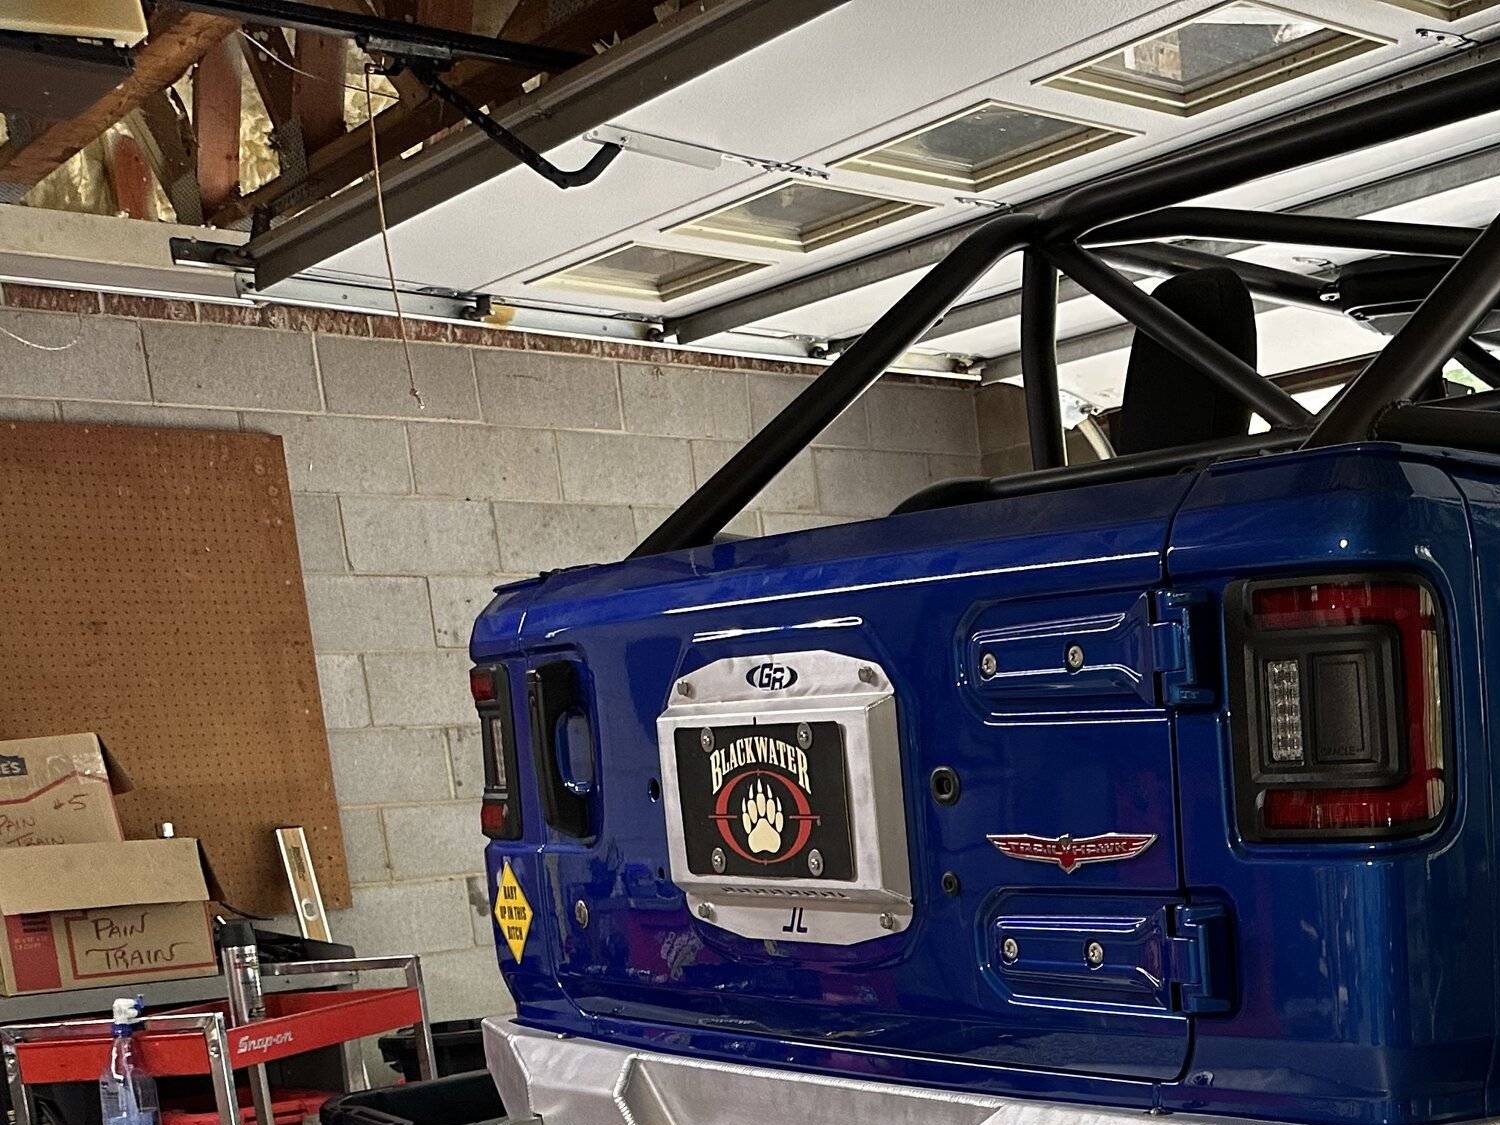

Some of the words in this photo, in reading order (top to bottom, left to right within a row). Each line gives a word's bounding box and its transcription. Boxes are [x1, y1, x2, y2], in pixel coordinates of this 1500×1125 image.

[709, 735, 812, 796] BLACKWATER
[503, 886, 517, 900] BABY
[514, 907, 527, 921] THIS
[782, 907, 808, 933] JL
[91, 913, 151, 941] PAIN
[507, 926, 523, 940] BITCH
[86, 942, 193, 969] TRAIN
[237, 1031, 294, 1054] Snap-on
